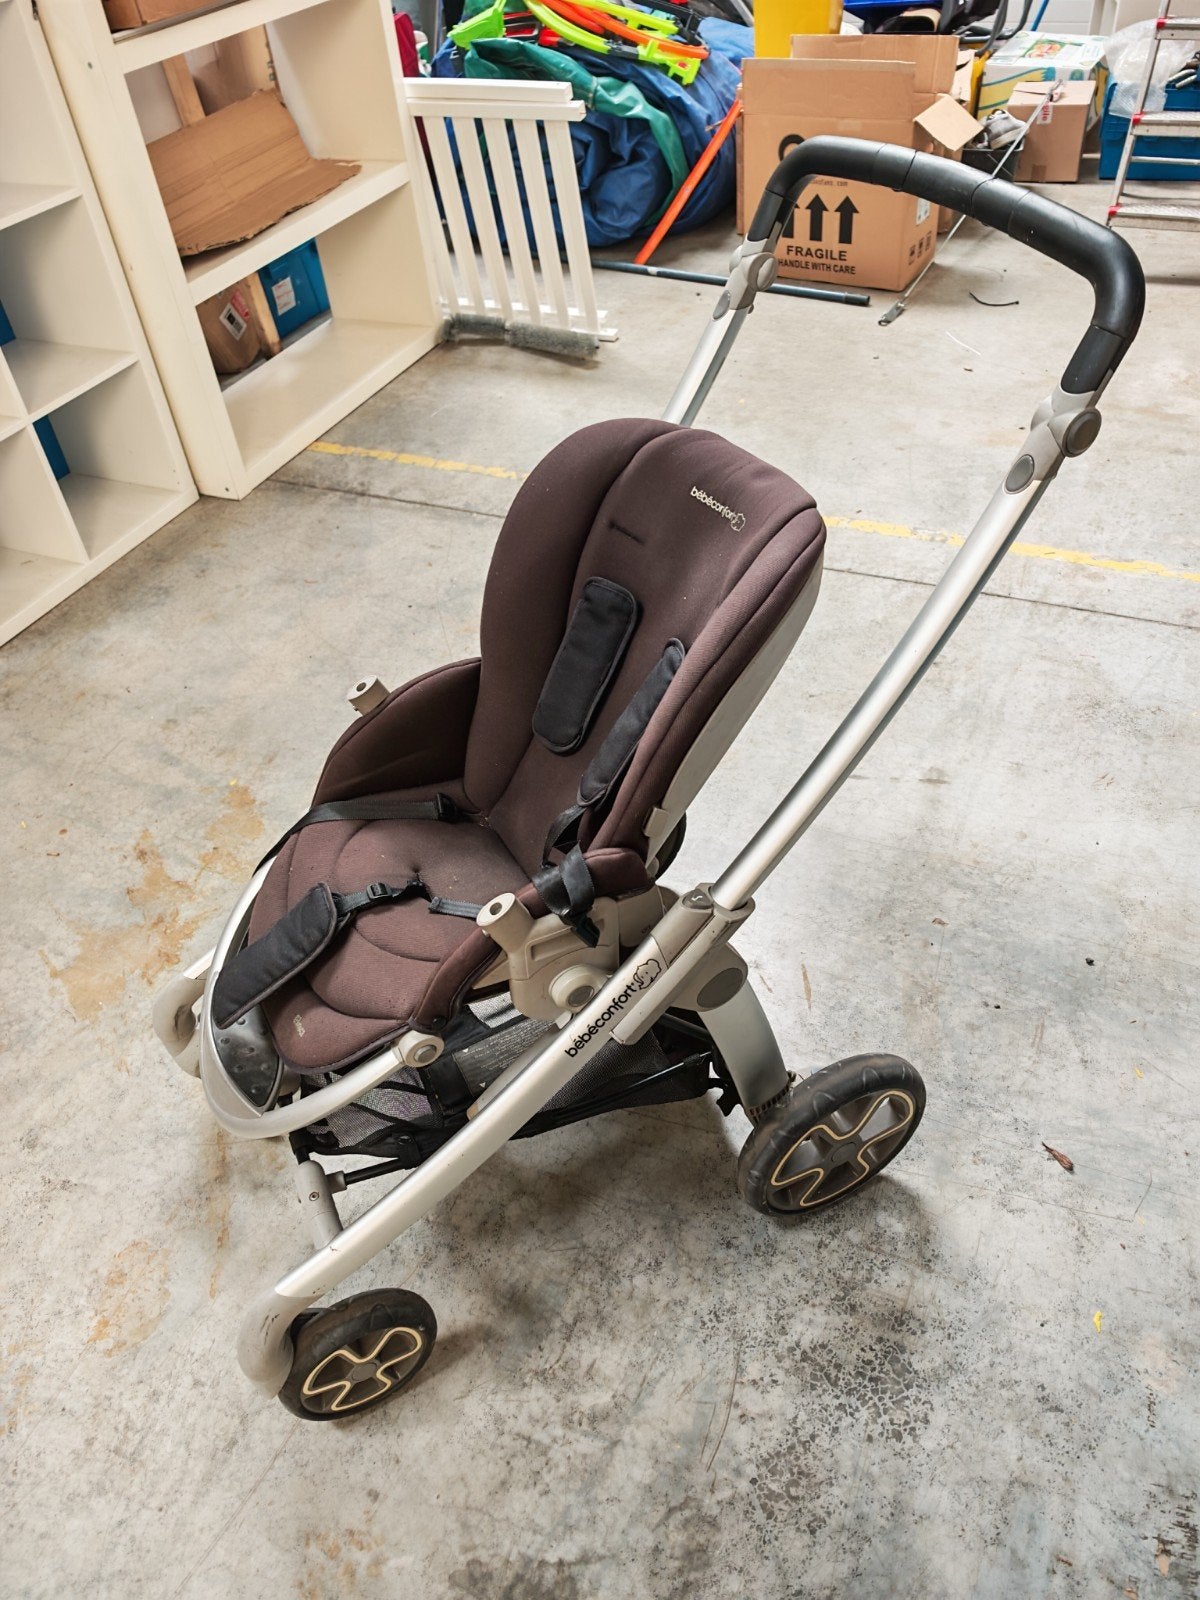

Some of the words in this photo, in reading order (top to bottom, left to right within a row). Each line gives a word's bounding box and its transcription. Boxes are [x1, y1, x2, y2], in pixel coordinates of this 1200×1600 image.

[786, 245, 847, 261] FRAGILE
[778, 259, 810, 269] HANDLE
[811, 262, 831, 272] WITH
[833, 264, 856, 275] CARE
[565, 983, 637, 1058] bébéconfort
